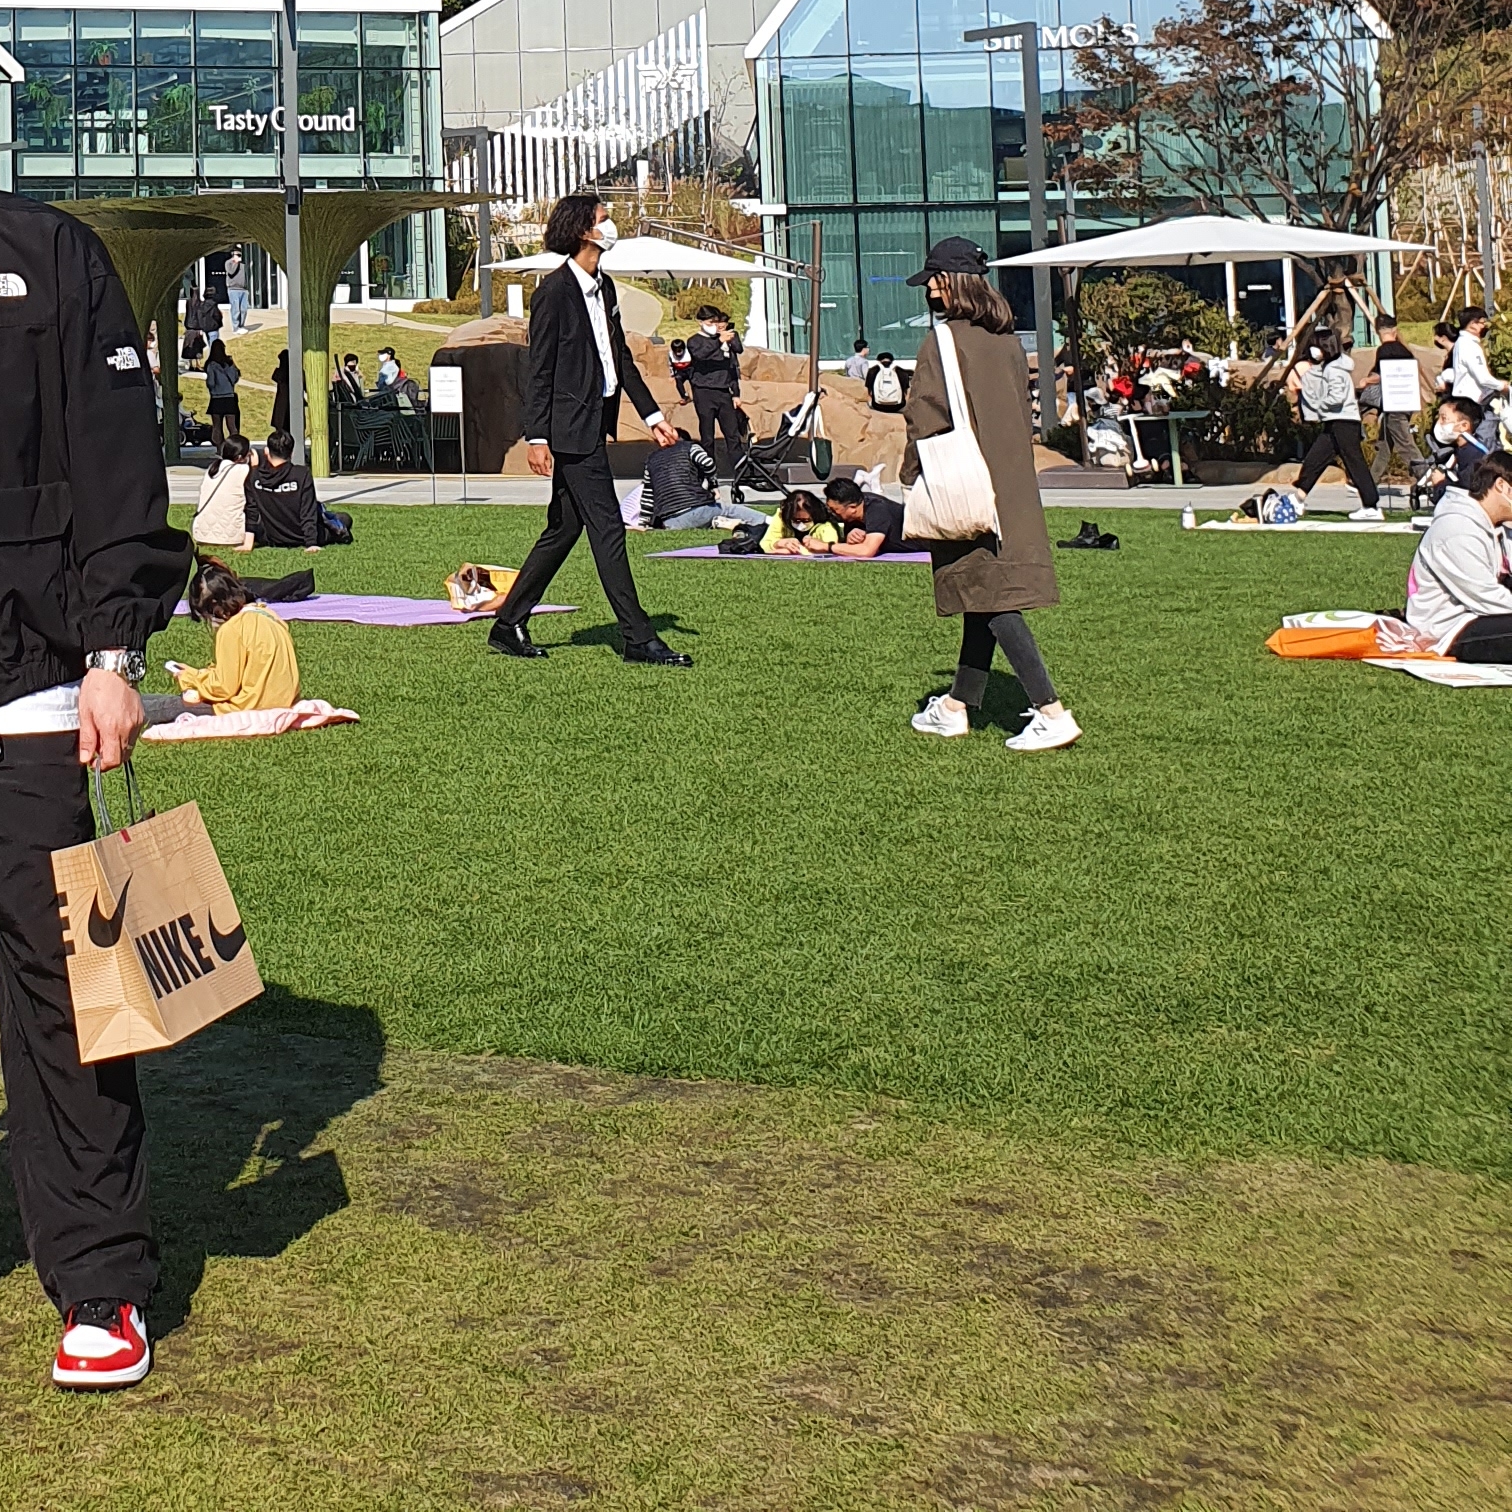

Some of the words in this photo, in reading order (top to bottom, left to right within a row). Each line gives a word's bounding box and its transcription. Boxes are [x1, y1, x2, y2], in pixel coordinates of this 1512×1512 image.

[983, 23, 1140, 51] SIMOS
[208, 104, 268, 136] Tasty
[270, 106, 356, 132] Gound
[134, 912, 217, 1001] NIKE
